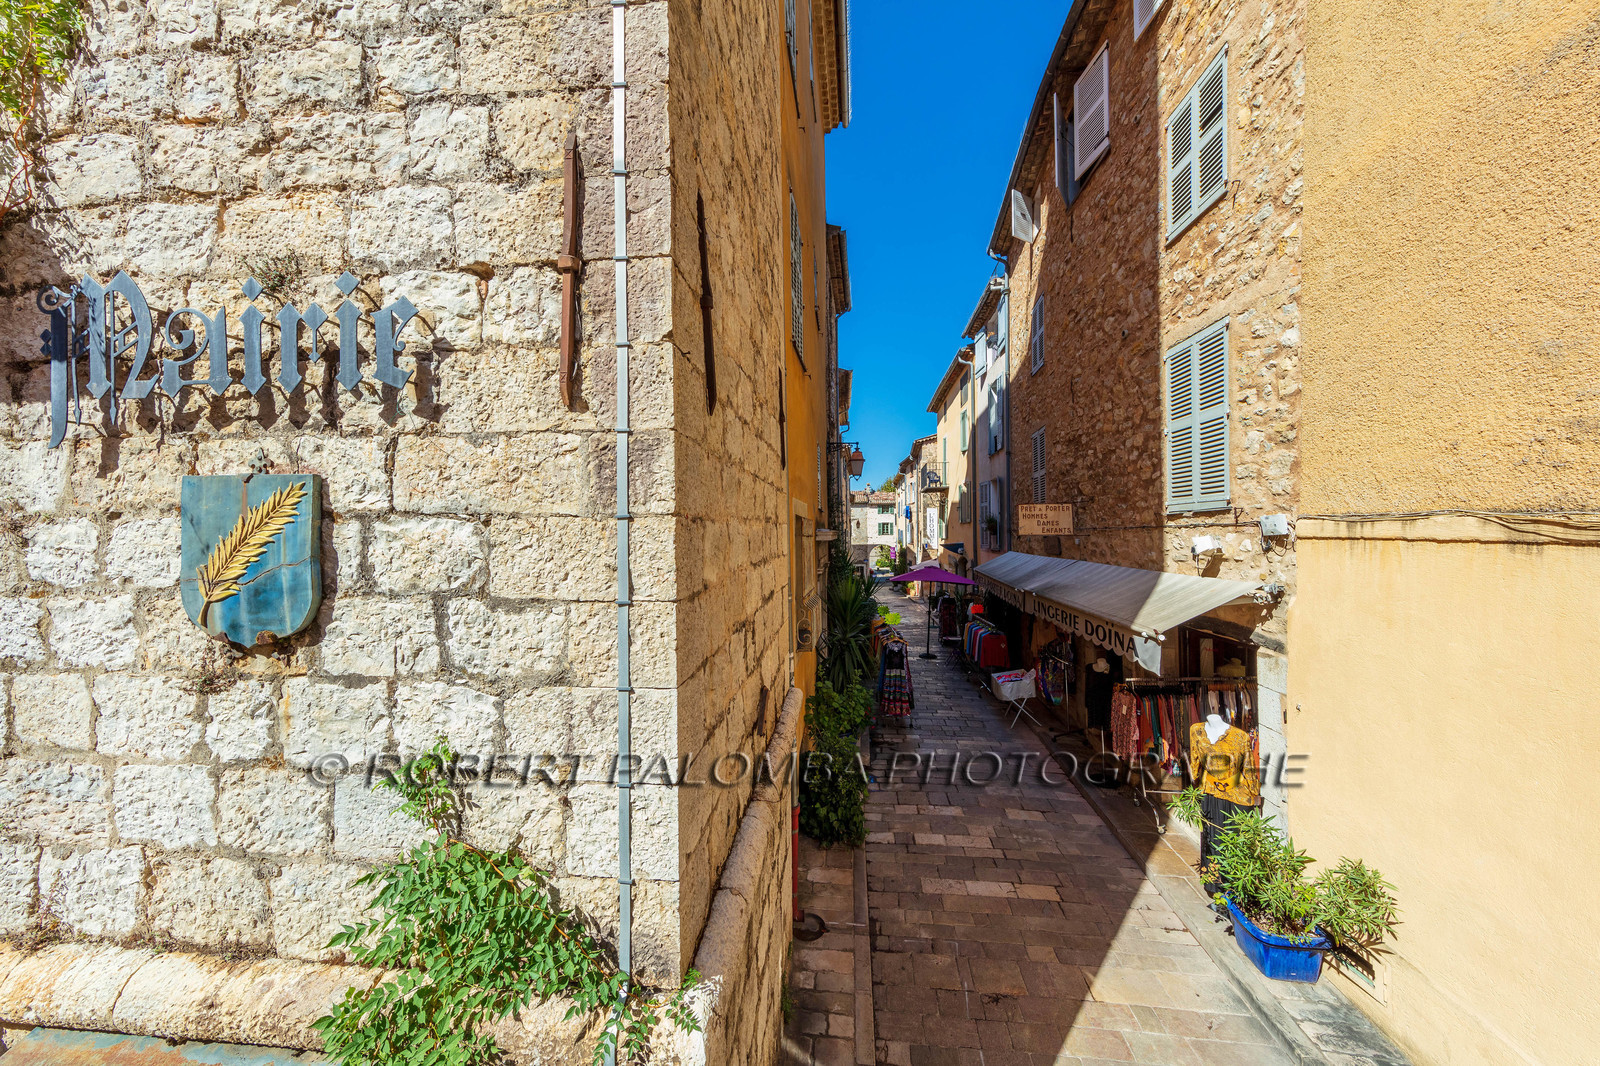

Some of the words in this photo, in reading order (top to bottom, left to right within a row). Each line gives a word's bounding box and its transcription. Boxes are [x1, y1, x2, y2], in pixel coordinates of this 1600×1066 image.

[37, 270, 419, 449] Mairie
[1041, 526, 1072, 534] ENFANTS
[1033, 599, 1080, 631] LINGERIE
[1084, 618, 1140, 659] DOÏNA
